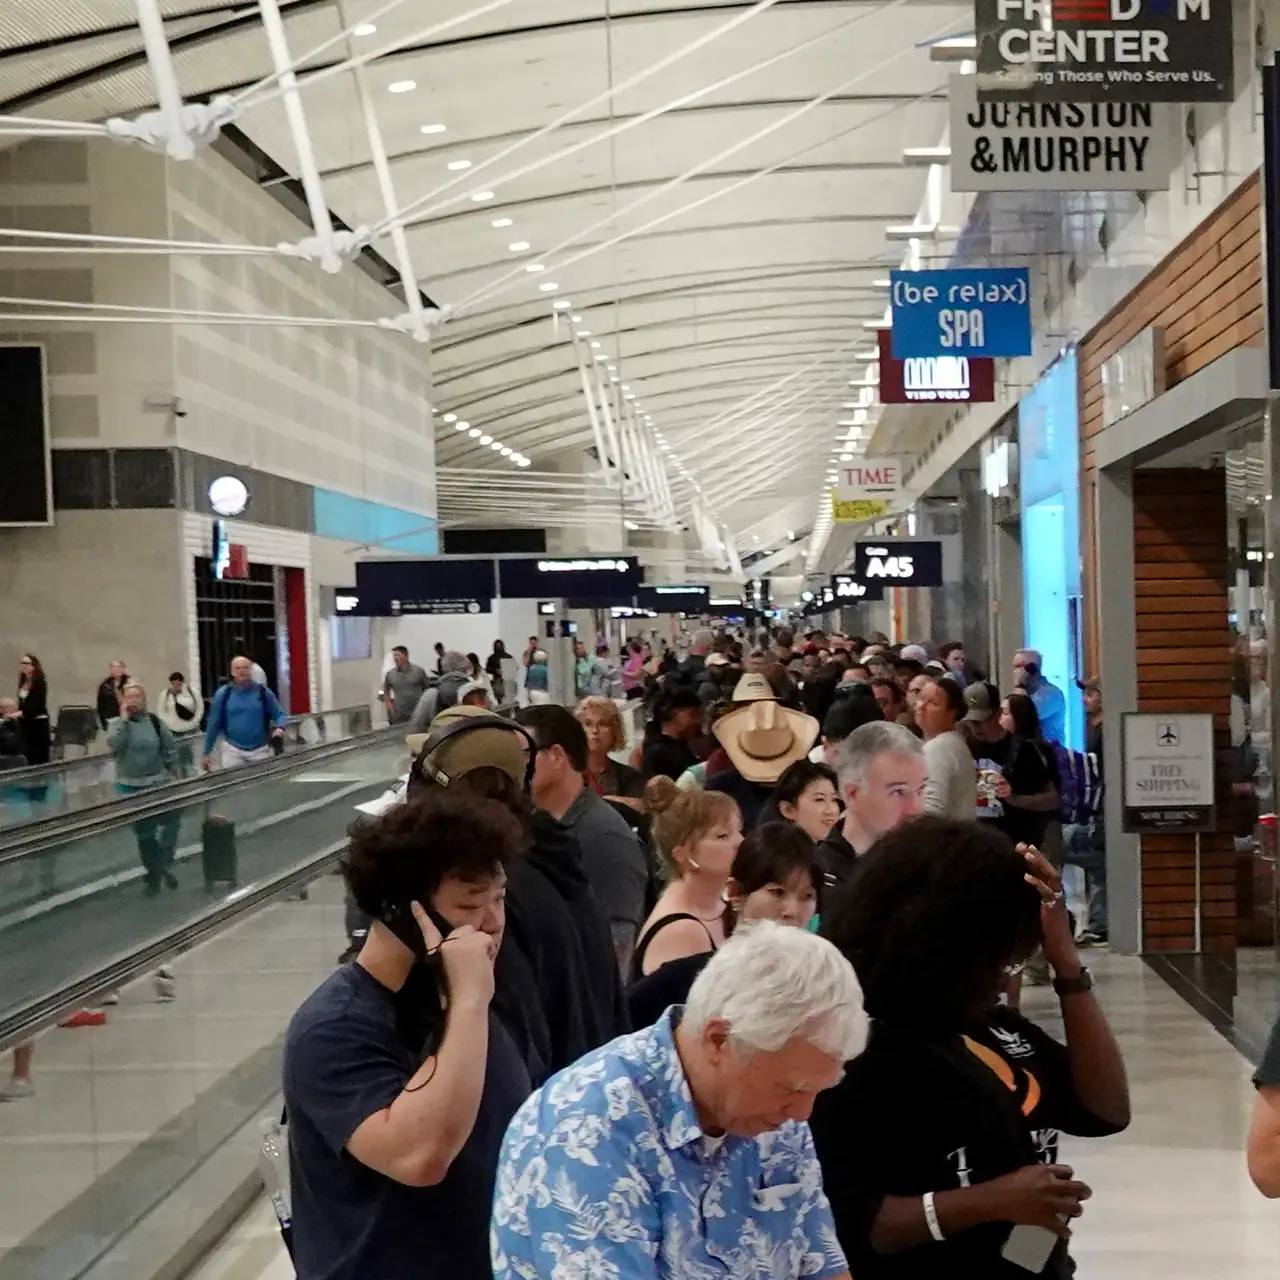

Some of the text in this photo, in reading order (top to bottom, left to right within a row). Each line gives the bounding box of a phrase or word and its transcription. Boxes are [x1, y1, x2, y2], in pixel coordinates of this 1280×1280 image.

[998, 28, 1169, 63] CENTER
[1058, 70, 1104, 82] Those
[1107, 70, 1143, 82] Who
[1145, 70, 1189, 82] Serve
[1192, 70, 1216, 82] Us.
[893, 278, 1027, 307] (be relax)
[938, 309, 985, 347] SPA
[843, 467, 897, 485] TIME
[866, 556, 914, 578] A45
